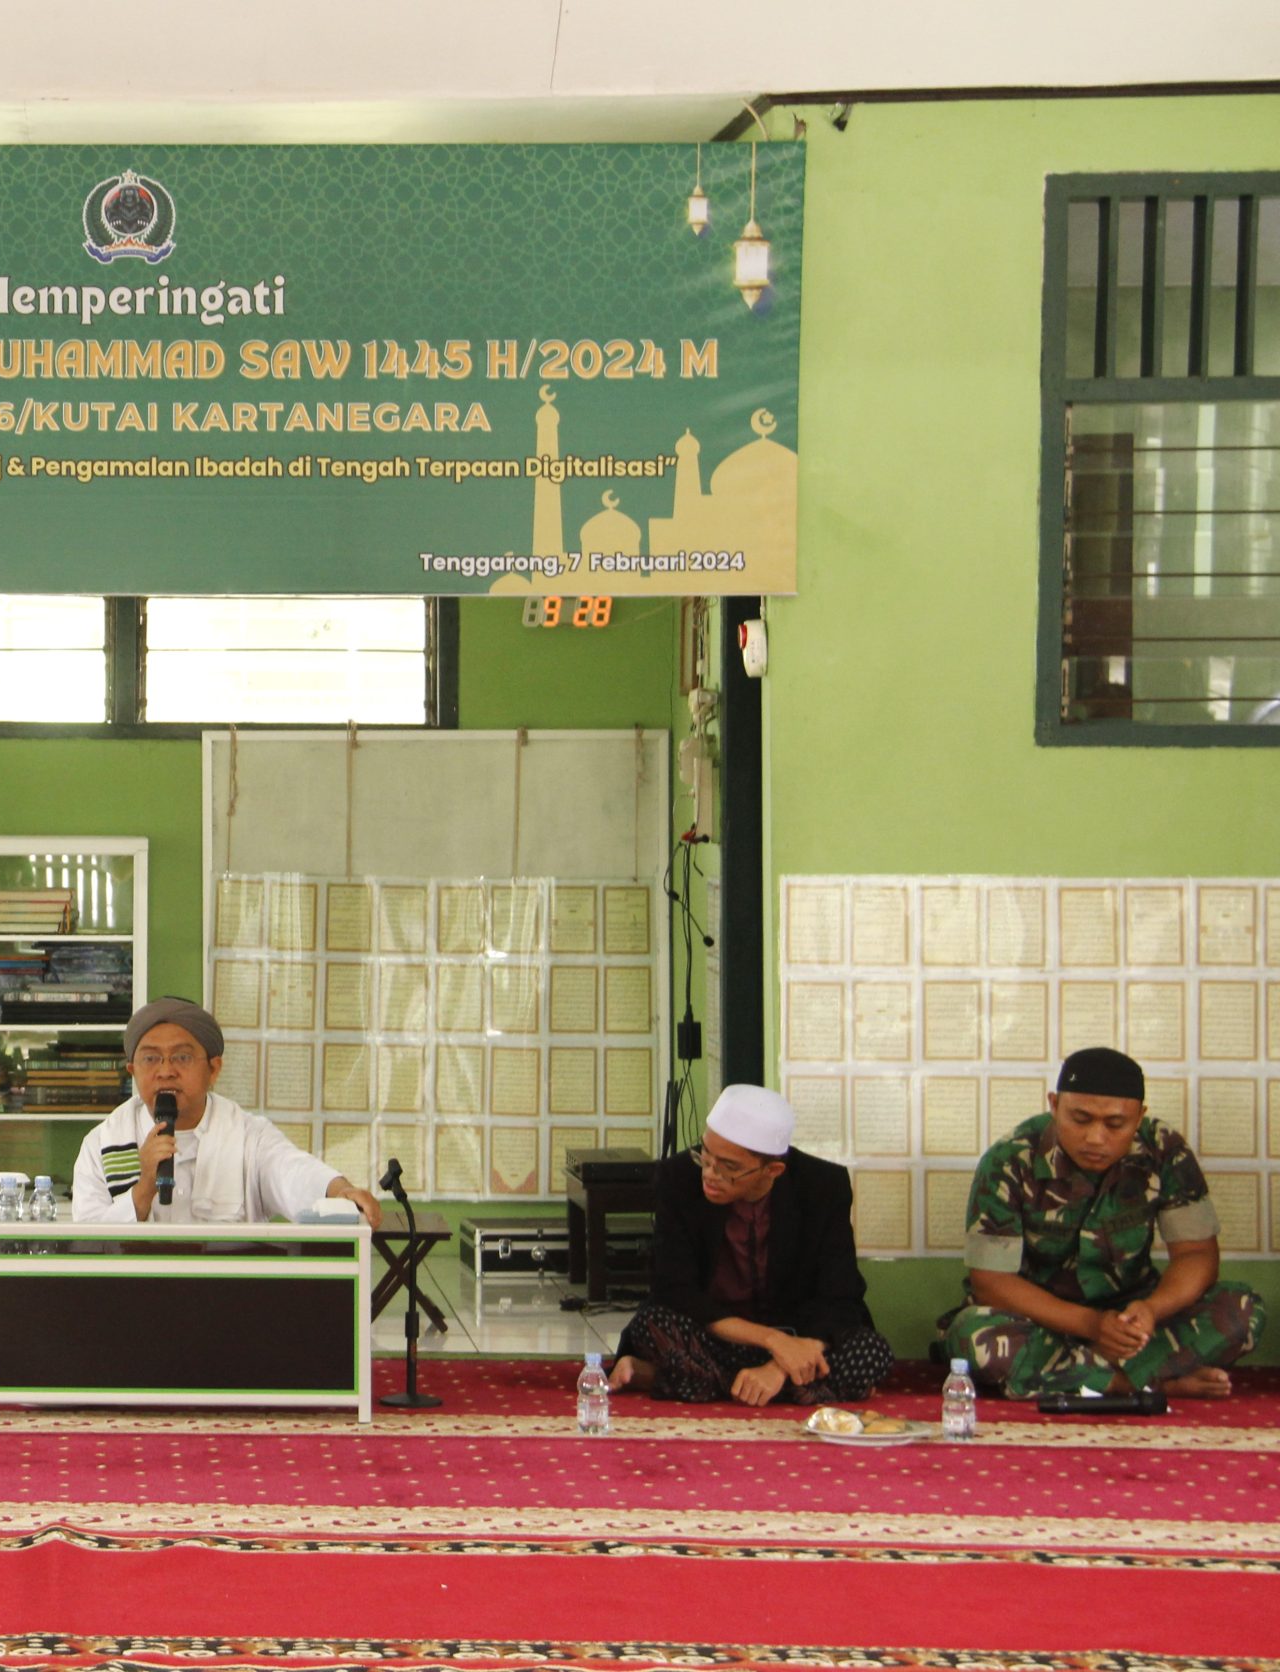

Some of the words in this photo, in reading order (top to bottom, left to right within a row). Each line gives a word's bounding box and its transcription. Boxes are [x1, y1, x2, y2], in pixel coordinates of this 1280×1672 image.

[239, 339, 352, 380] SAW
[362, 339, 473, 380] 1445
[486, 338, 667, 380] H/2024
[679, 338, 719, 379] M
[172, 402, 493, 433] KARTANEGARA
[6, 456, 26, 477] &
[31, 456, 191, 483] Pengamalan
[194, 456, 284, 478] Ibadah
[287, 455, 312, 477] di
[315, 456, 411, 483] Tengah
[415, 457, 520, 483] Terpaan
[524, 455, 677, 484] Digitalisasi”
[419, 552, 565, 577] Tenggarong,
[568, 552, 582, 571] 7
[589, 552, 686, 572] Februari
[689, 552, 745, 571] 2024
